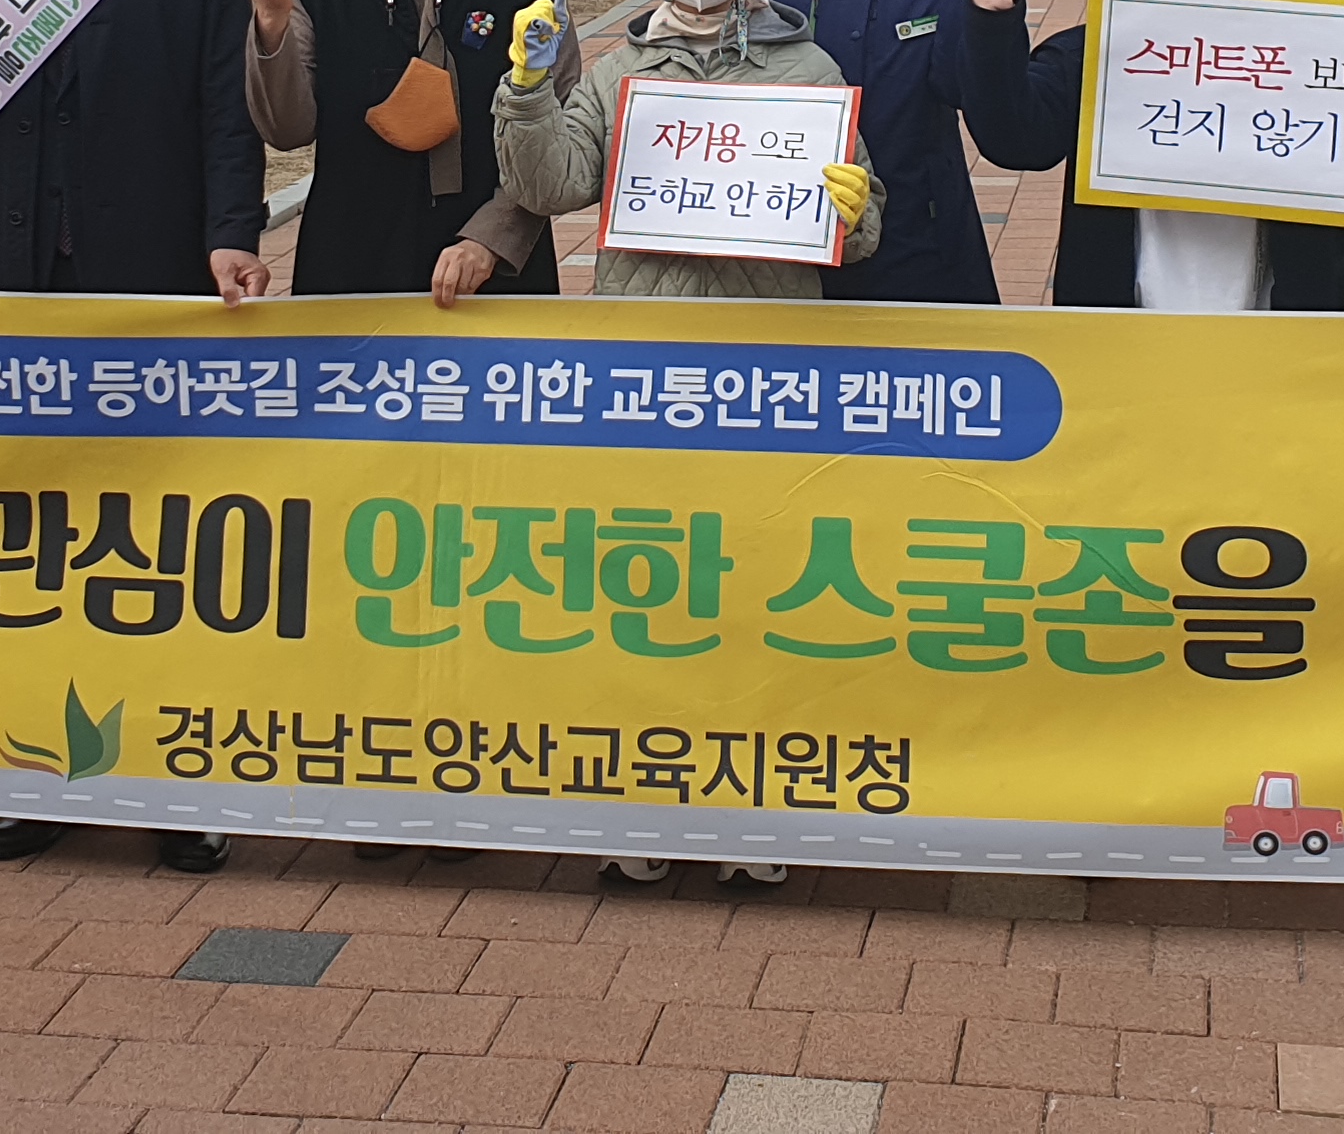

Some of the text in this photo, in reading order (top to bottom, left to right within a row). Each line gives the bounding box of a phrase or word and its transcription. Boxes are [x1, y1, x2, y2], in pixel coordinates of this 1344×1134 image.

[1123, 36, 1293, 91] 스마트폰
[1138, 99, 1341, 164] 걷지 않기
[622, 175, 825, 223] 등하교 안 하기
[88, 358, 300, 419] 등하굣길
[313, 360, 467, 423] 조성을
[483, 360, 593, 424] 위한
[602, 366, 821, 430] 교통안전
[837, 369, 1005, 438] 캠페인
[344, 497, 734, 658] 안전한
[763, 516, 1317, 682] 스쿨존을
[155, 705, 912, 816] 경상남도양산교육지원청
